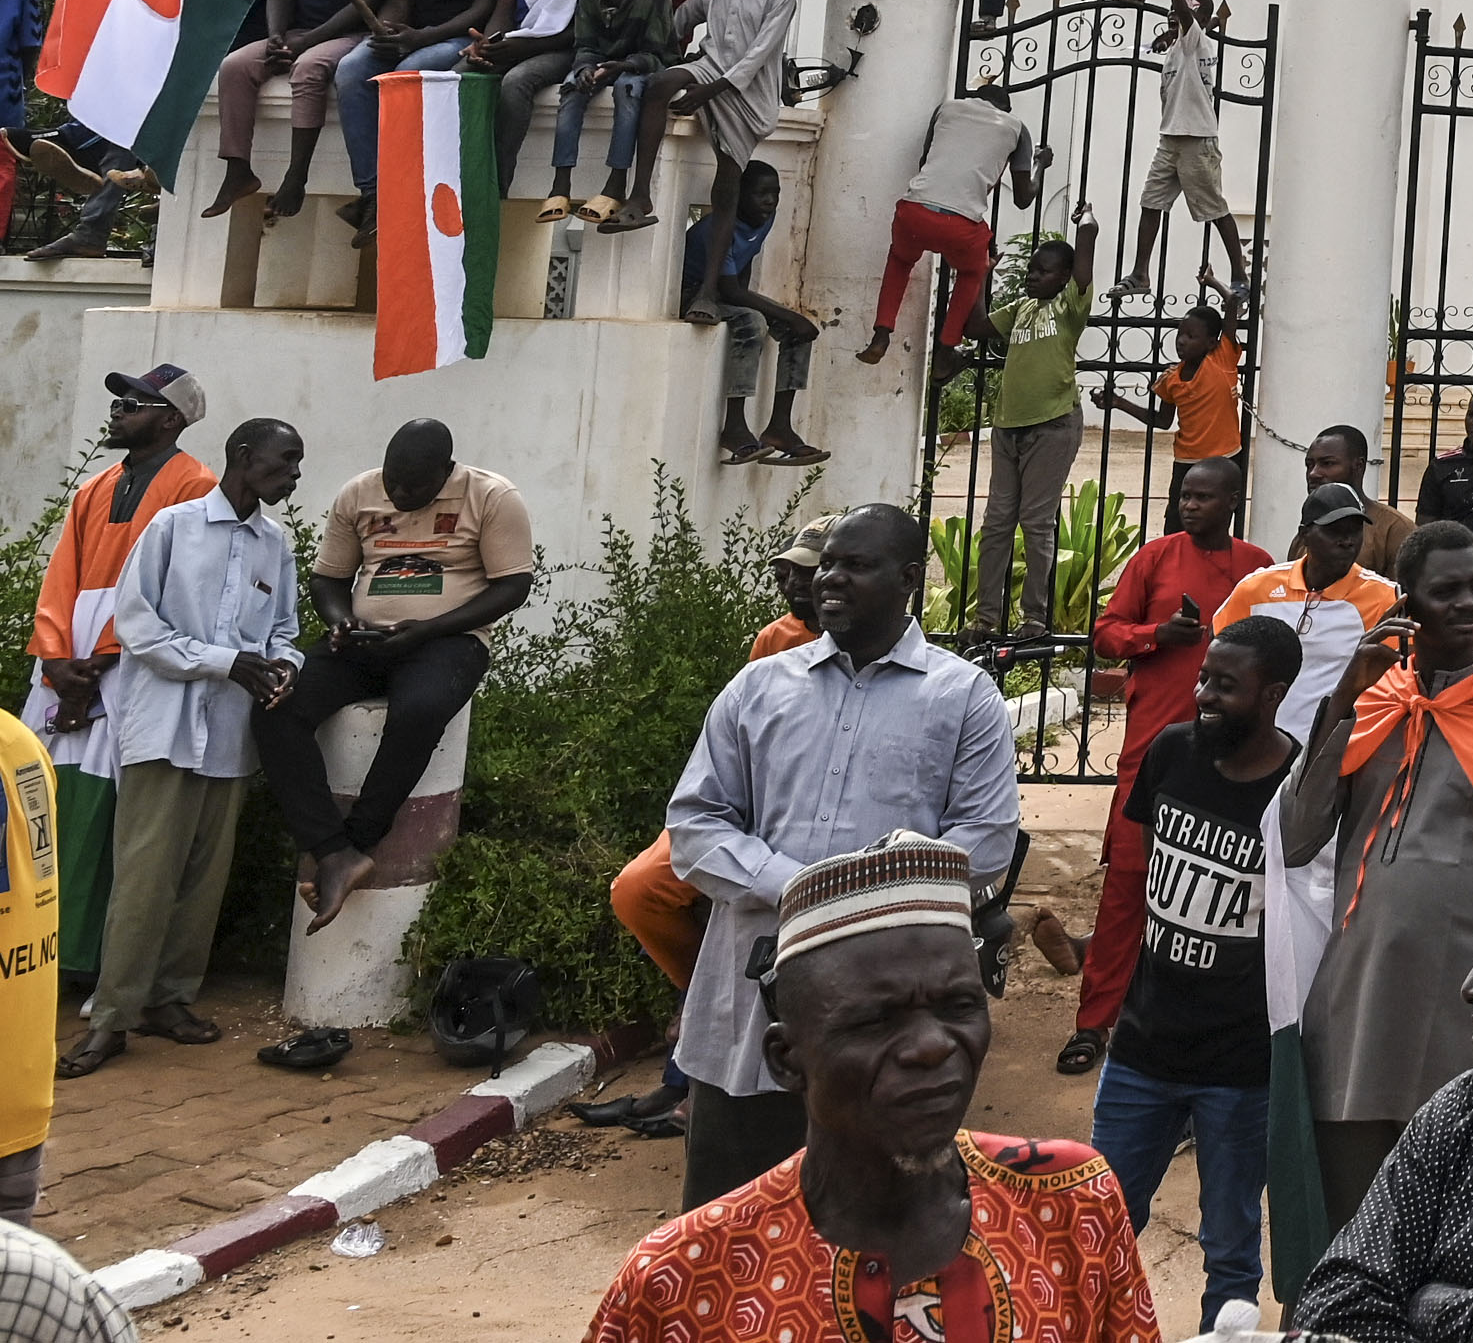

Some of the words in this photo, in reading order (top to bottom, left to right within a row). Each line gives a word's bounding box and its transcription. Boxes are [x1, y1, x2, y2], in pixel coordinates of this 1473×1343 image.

[1148, 847, 1253, 929] OUTTA
[1169, 931, 1217, 969] BED
[989, 1272, 1010, 1343] TRAVAI
